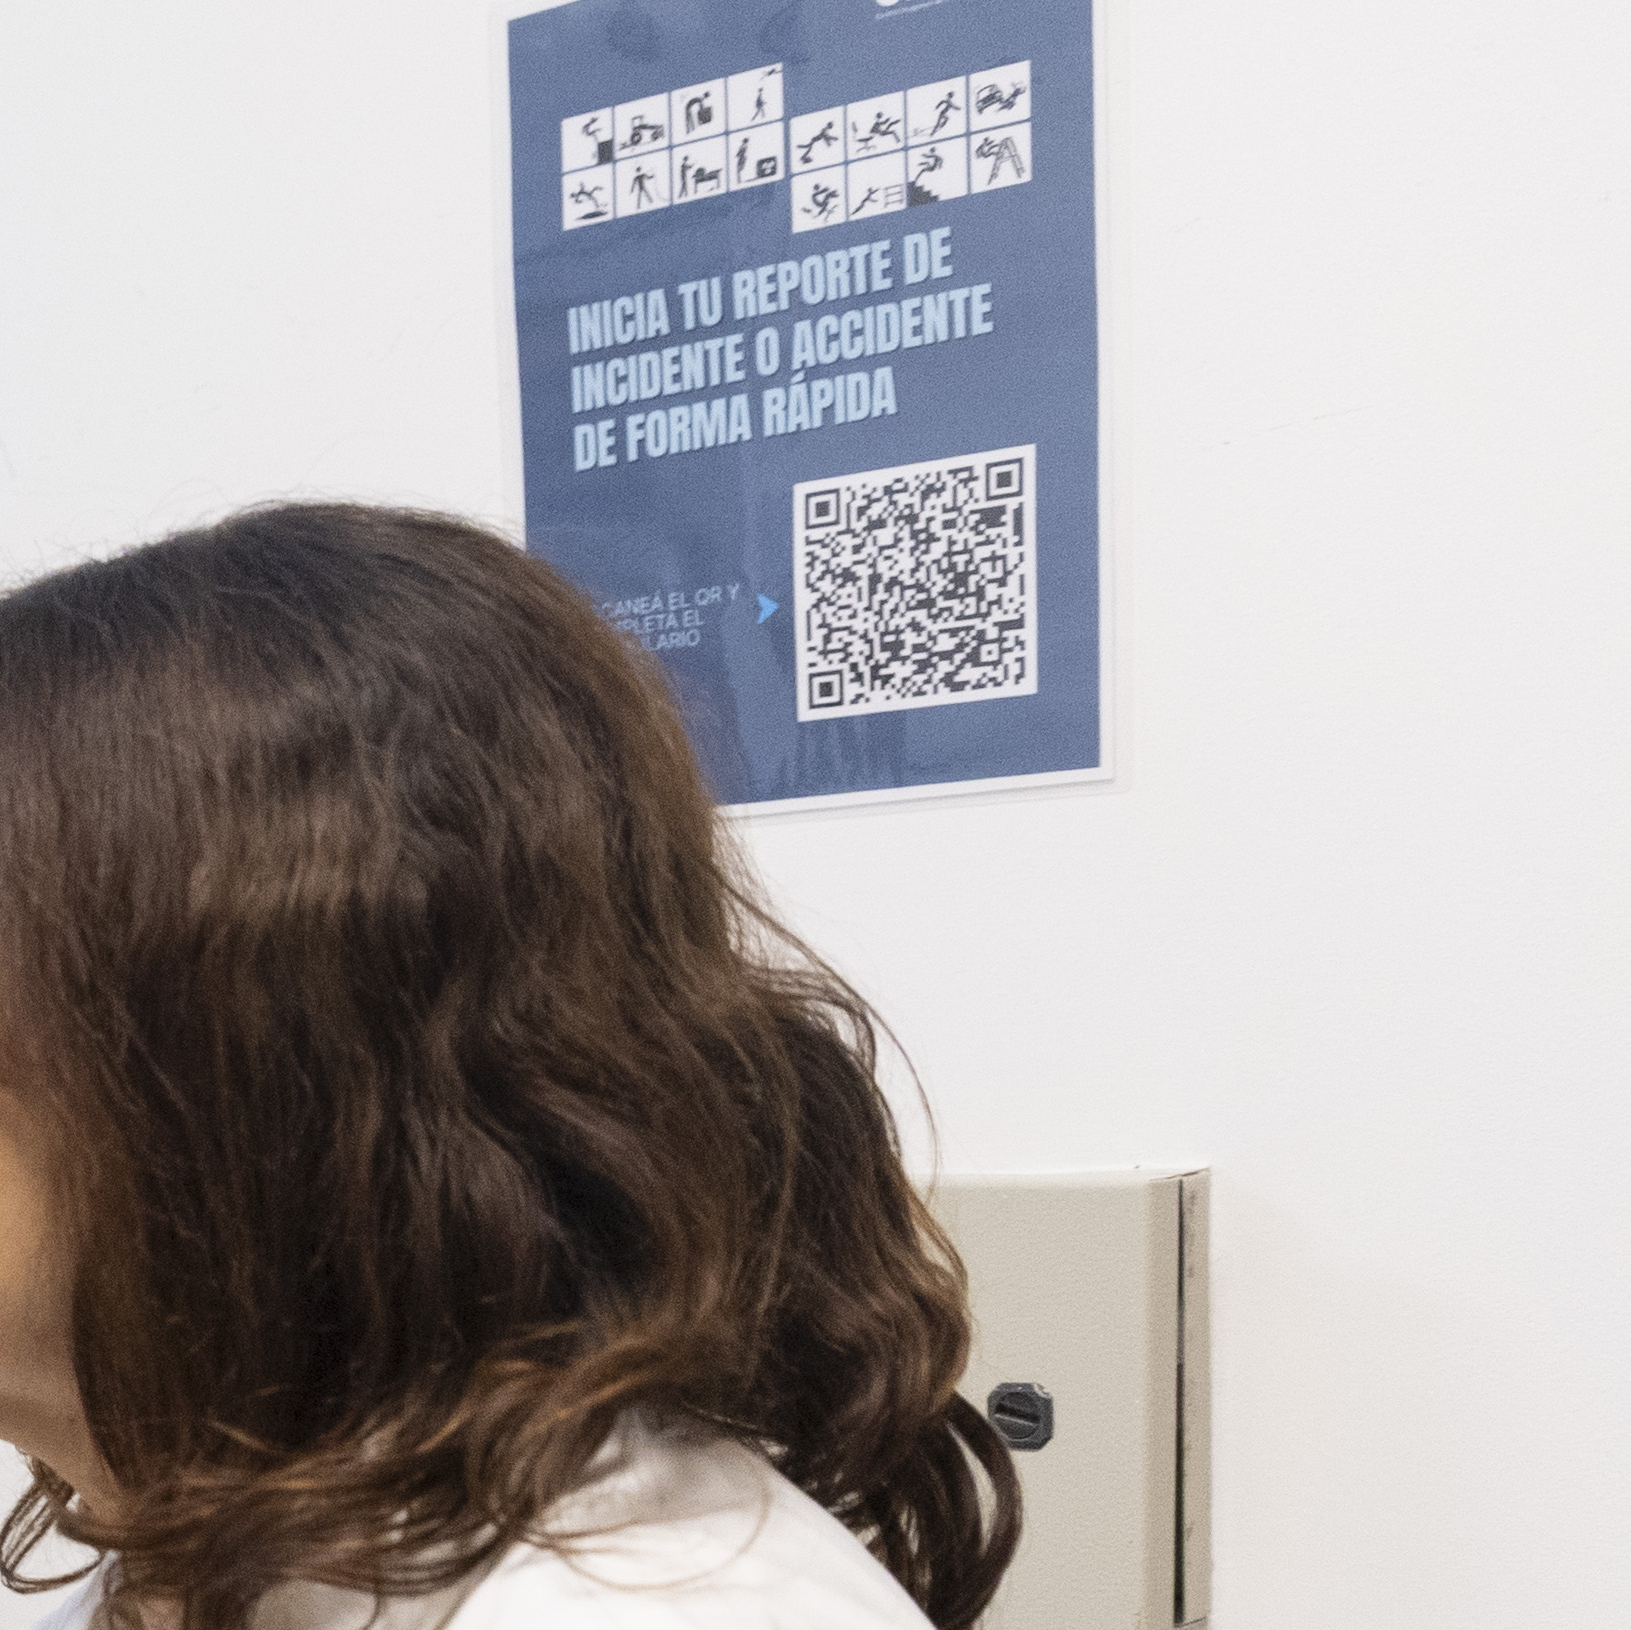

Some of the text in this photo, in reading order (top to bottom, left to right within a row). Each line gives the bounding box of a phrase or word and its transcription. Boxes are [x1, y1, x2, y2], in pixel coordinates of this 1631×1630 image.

[567, 226, 953, 355] INICIA TU REPORTE DE
[571, 282, 994, 414] INCIDENTE O ACCIDENTE
[574, 366, 898, 473] DE FORMA RÁPIDA
[668, 592, 690, 612] EL
[695, 585, 724, 607] QR
[727, 583, 740, 601] Y
[682, 609, 705, 629] EL
